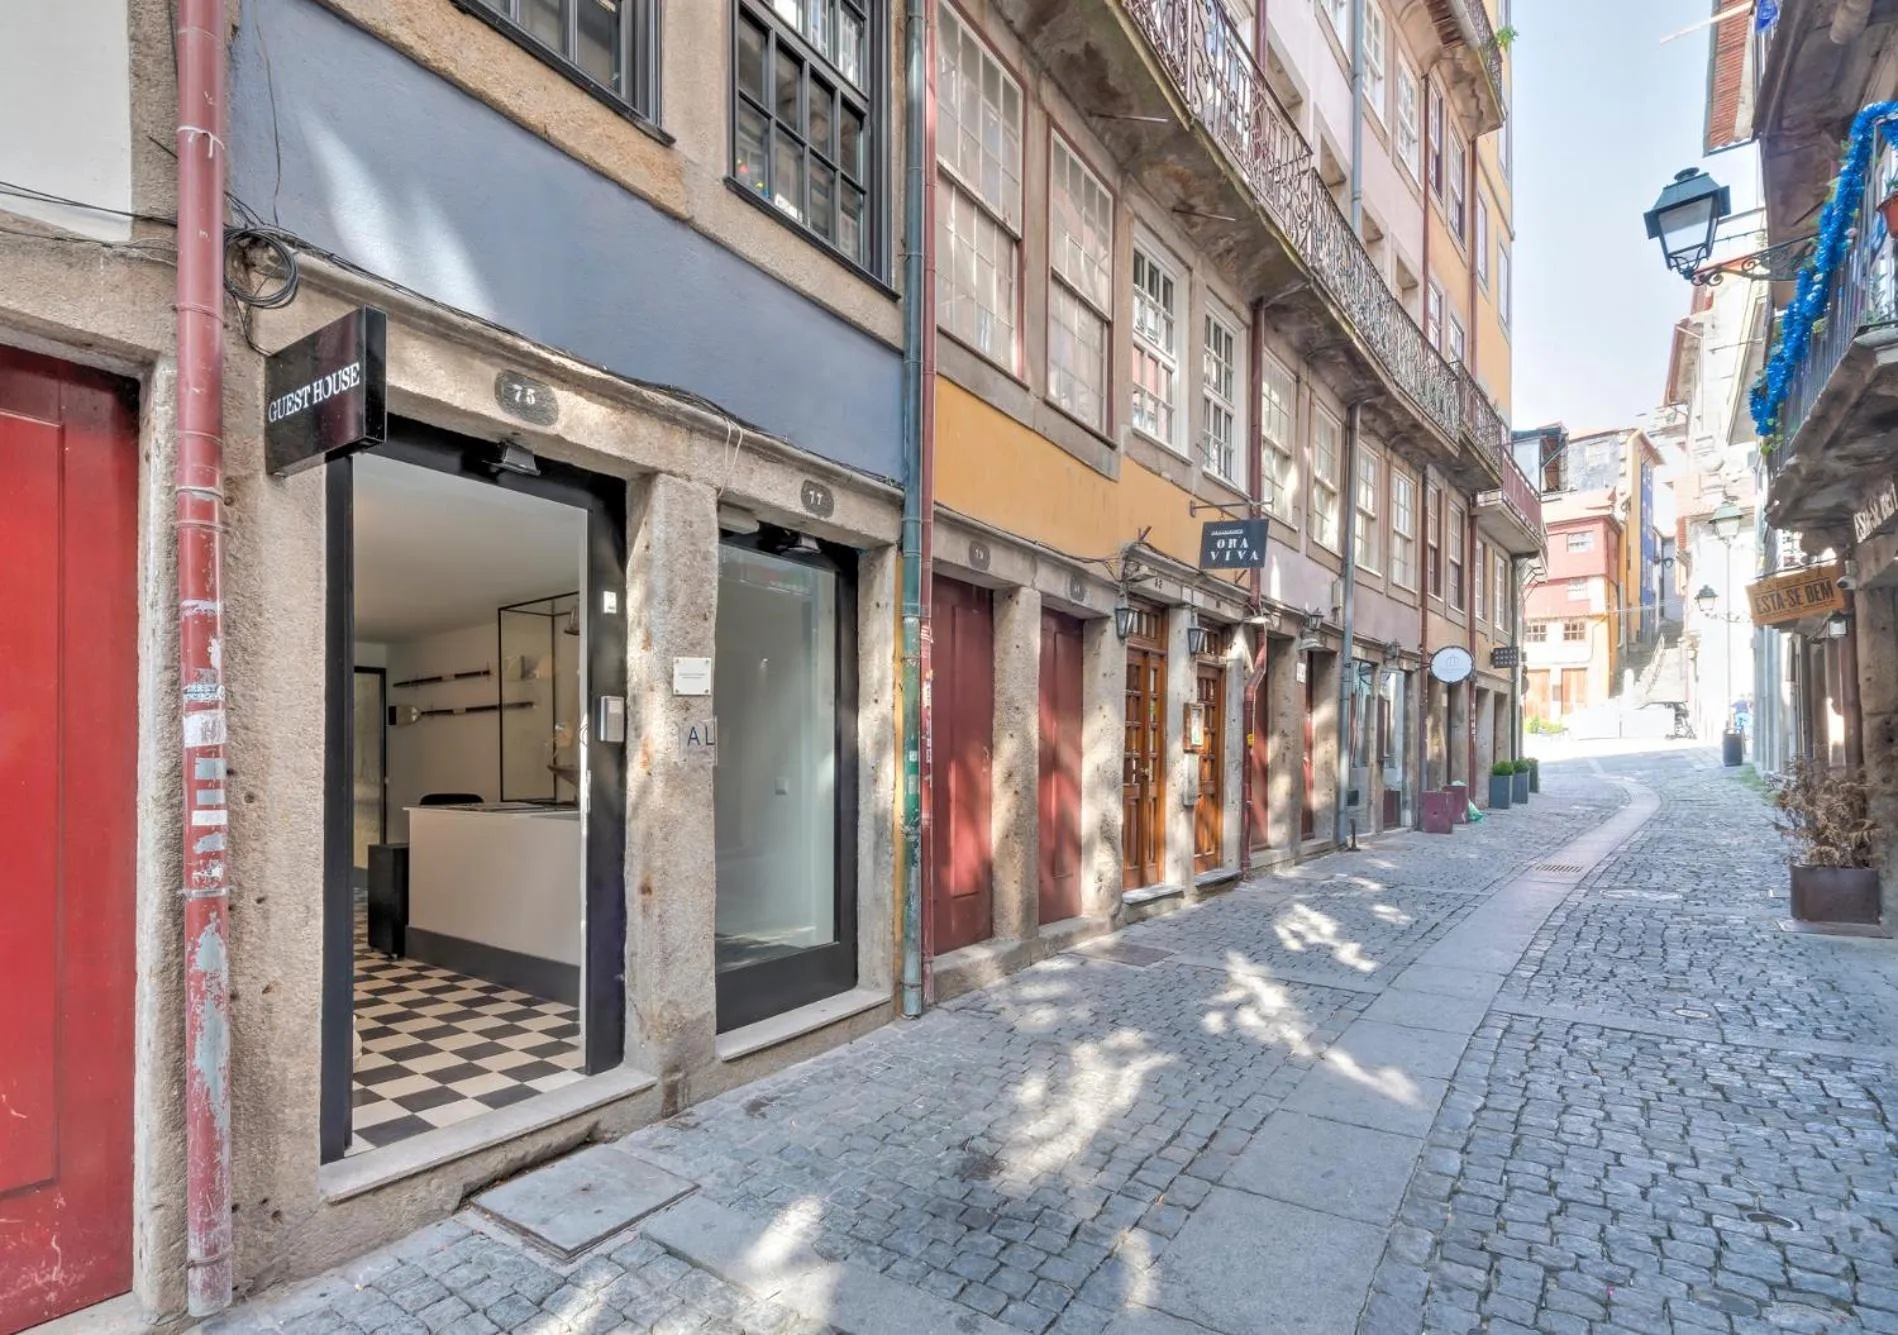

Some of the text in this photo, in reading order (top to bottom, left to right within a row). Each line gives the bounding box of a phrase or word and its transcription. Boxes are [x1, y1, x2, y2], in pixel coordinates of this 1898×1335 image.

[268, 362, 360, 423] GUEST HOUSE
[1216, 537, 1249, 549] ORA
[1210, 550, 1259, 561] VIVA
[1804, 579, 1834, 603] BEM
[687, 725, 715, 746] AL
